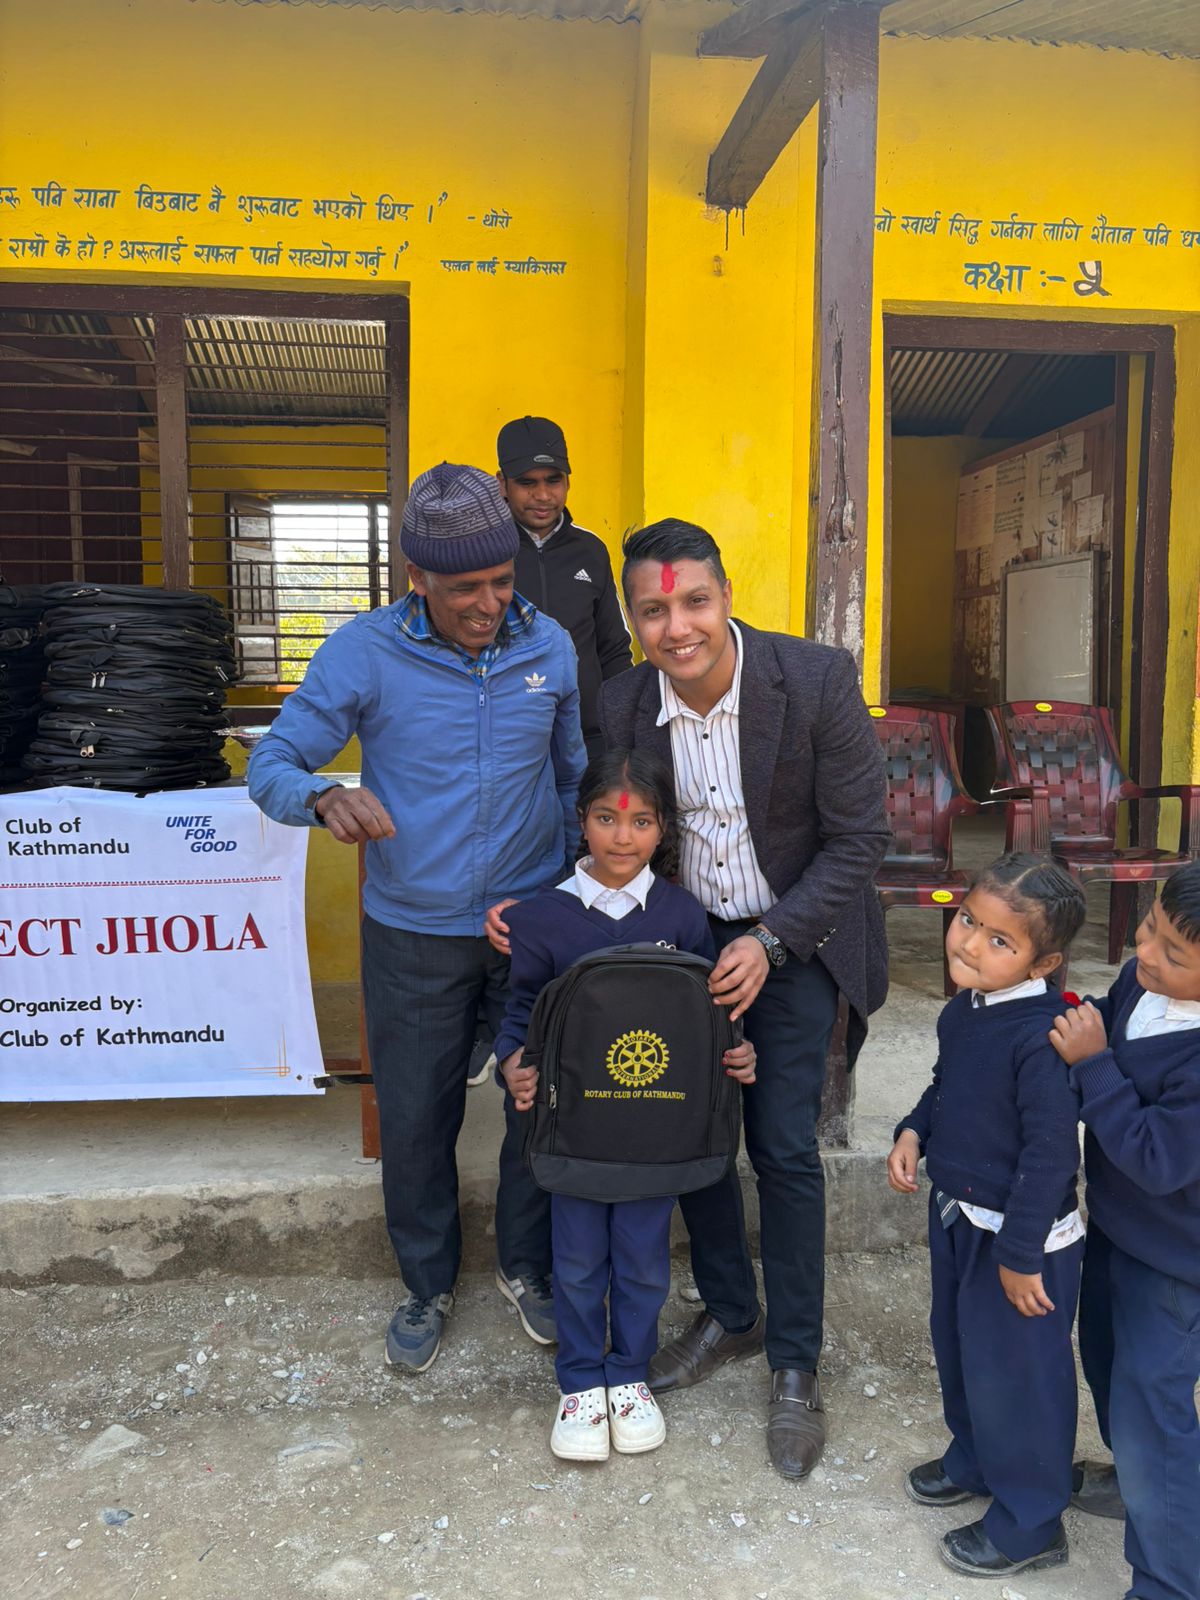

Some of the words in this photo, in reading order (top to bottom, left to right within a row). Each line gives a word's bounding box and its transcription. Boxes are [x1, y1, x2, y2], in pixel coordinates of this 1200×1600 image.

[30, 180, 67, 207] पनि
[73, 188, 121, 209] साना
[208, 184, 227, 213] नै
[312, 191, 367, 220] भएको
[374, 193, 415, 221] थिए
[482, 208, 513, 229] थोरो
[900, 210, 942, 235] स्वार्थ
[990, 212, 1038, 240] गर्नका
[1042, 217, 1084, 241] लागि
[1090, 214, 1137, 244] शैतान
[1142, 222, 1172, 246] पनि
[8, 231, 50, 259] राम्रो
[54, 232, 72, 257] के
[77, 233, 99, 261] हो
[193, 244, 244, 265] सफल
[249, 241, 284, 266] पार्न
[288, 239, 351, 269] सहयोग
[354, 245, 387, 277] गर्नु
[439, 259, 474, 272] एलन
[476, 256, 500, 276] लाई
[963, 261, 1032, 294] कक्षा
[5, 818, 53, 835] Club
[58, 816, 82, 834] of
[165, 815, 213, 828] UNITE
[184, 828, 217, 840] FOR
[7, 838, 130, 856] Kathmandu
[190, 840, 238, 853] GOOD
[96, 912, 268, 955] JHOLA
[0, 995, 102, 1017] Organized
[110, 995, 143, 1015] by:
[0, 1029, 49, 1048] Club
[59, 1027, 85, 1047] of
[96, 1024, 225, 1046] Kathmandu
[584, 1089, 613, 1099] ROTARY
[613, 1090, 632, 1099] CLUB
[632, 1090, 643, 1099] OF
[642, 1090, 686, 1101] KATHMANDU
